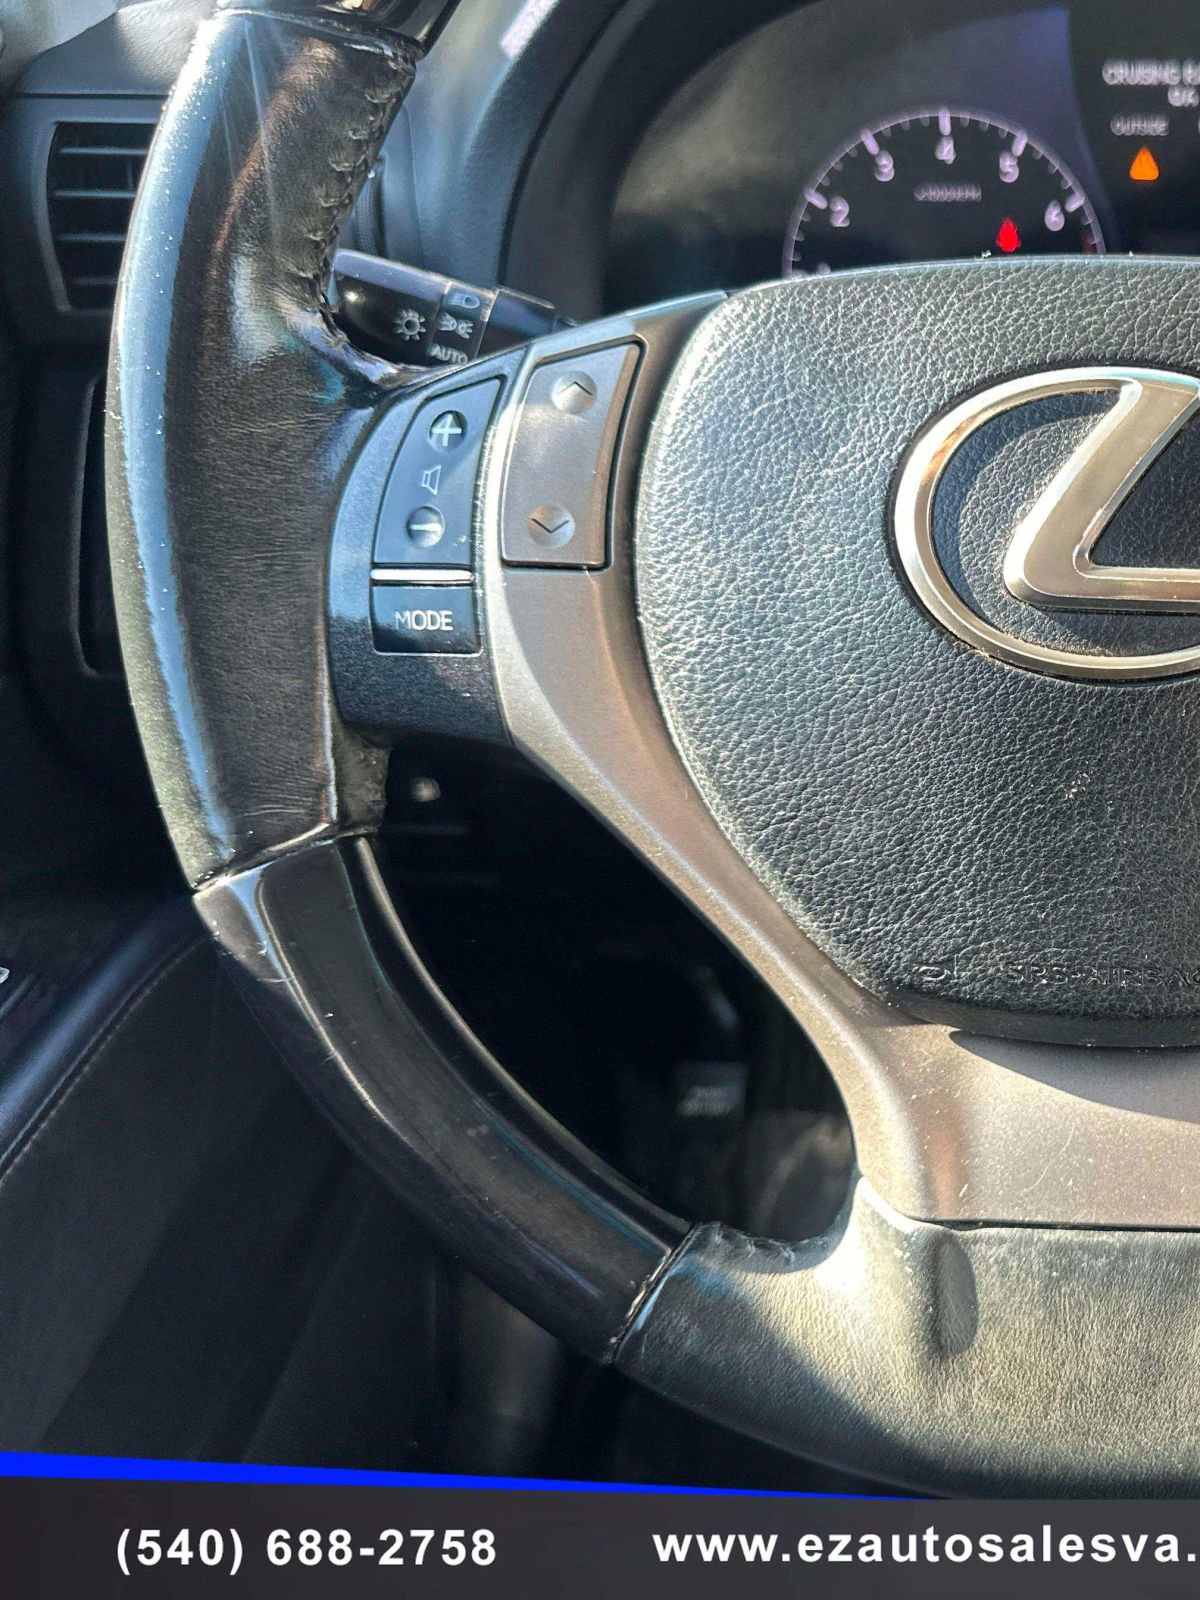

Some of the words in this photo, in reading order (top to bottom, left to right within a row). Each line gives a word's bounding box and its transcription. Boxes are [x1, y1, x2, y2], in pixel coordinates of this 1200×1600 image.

[935, 135, 956, 164] 4
[874, 150, 895, 182] 3
[1000, 151, 1019, 183] 5
[830, 197, 849, 228] 2
[1045, 200, 1065, 231] 6
[395, 610, 454, 631] MODE
